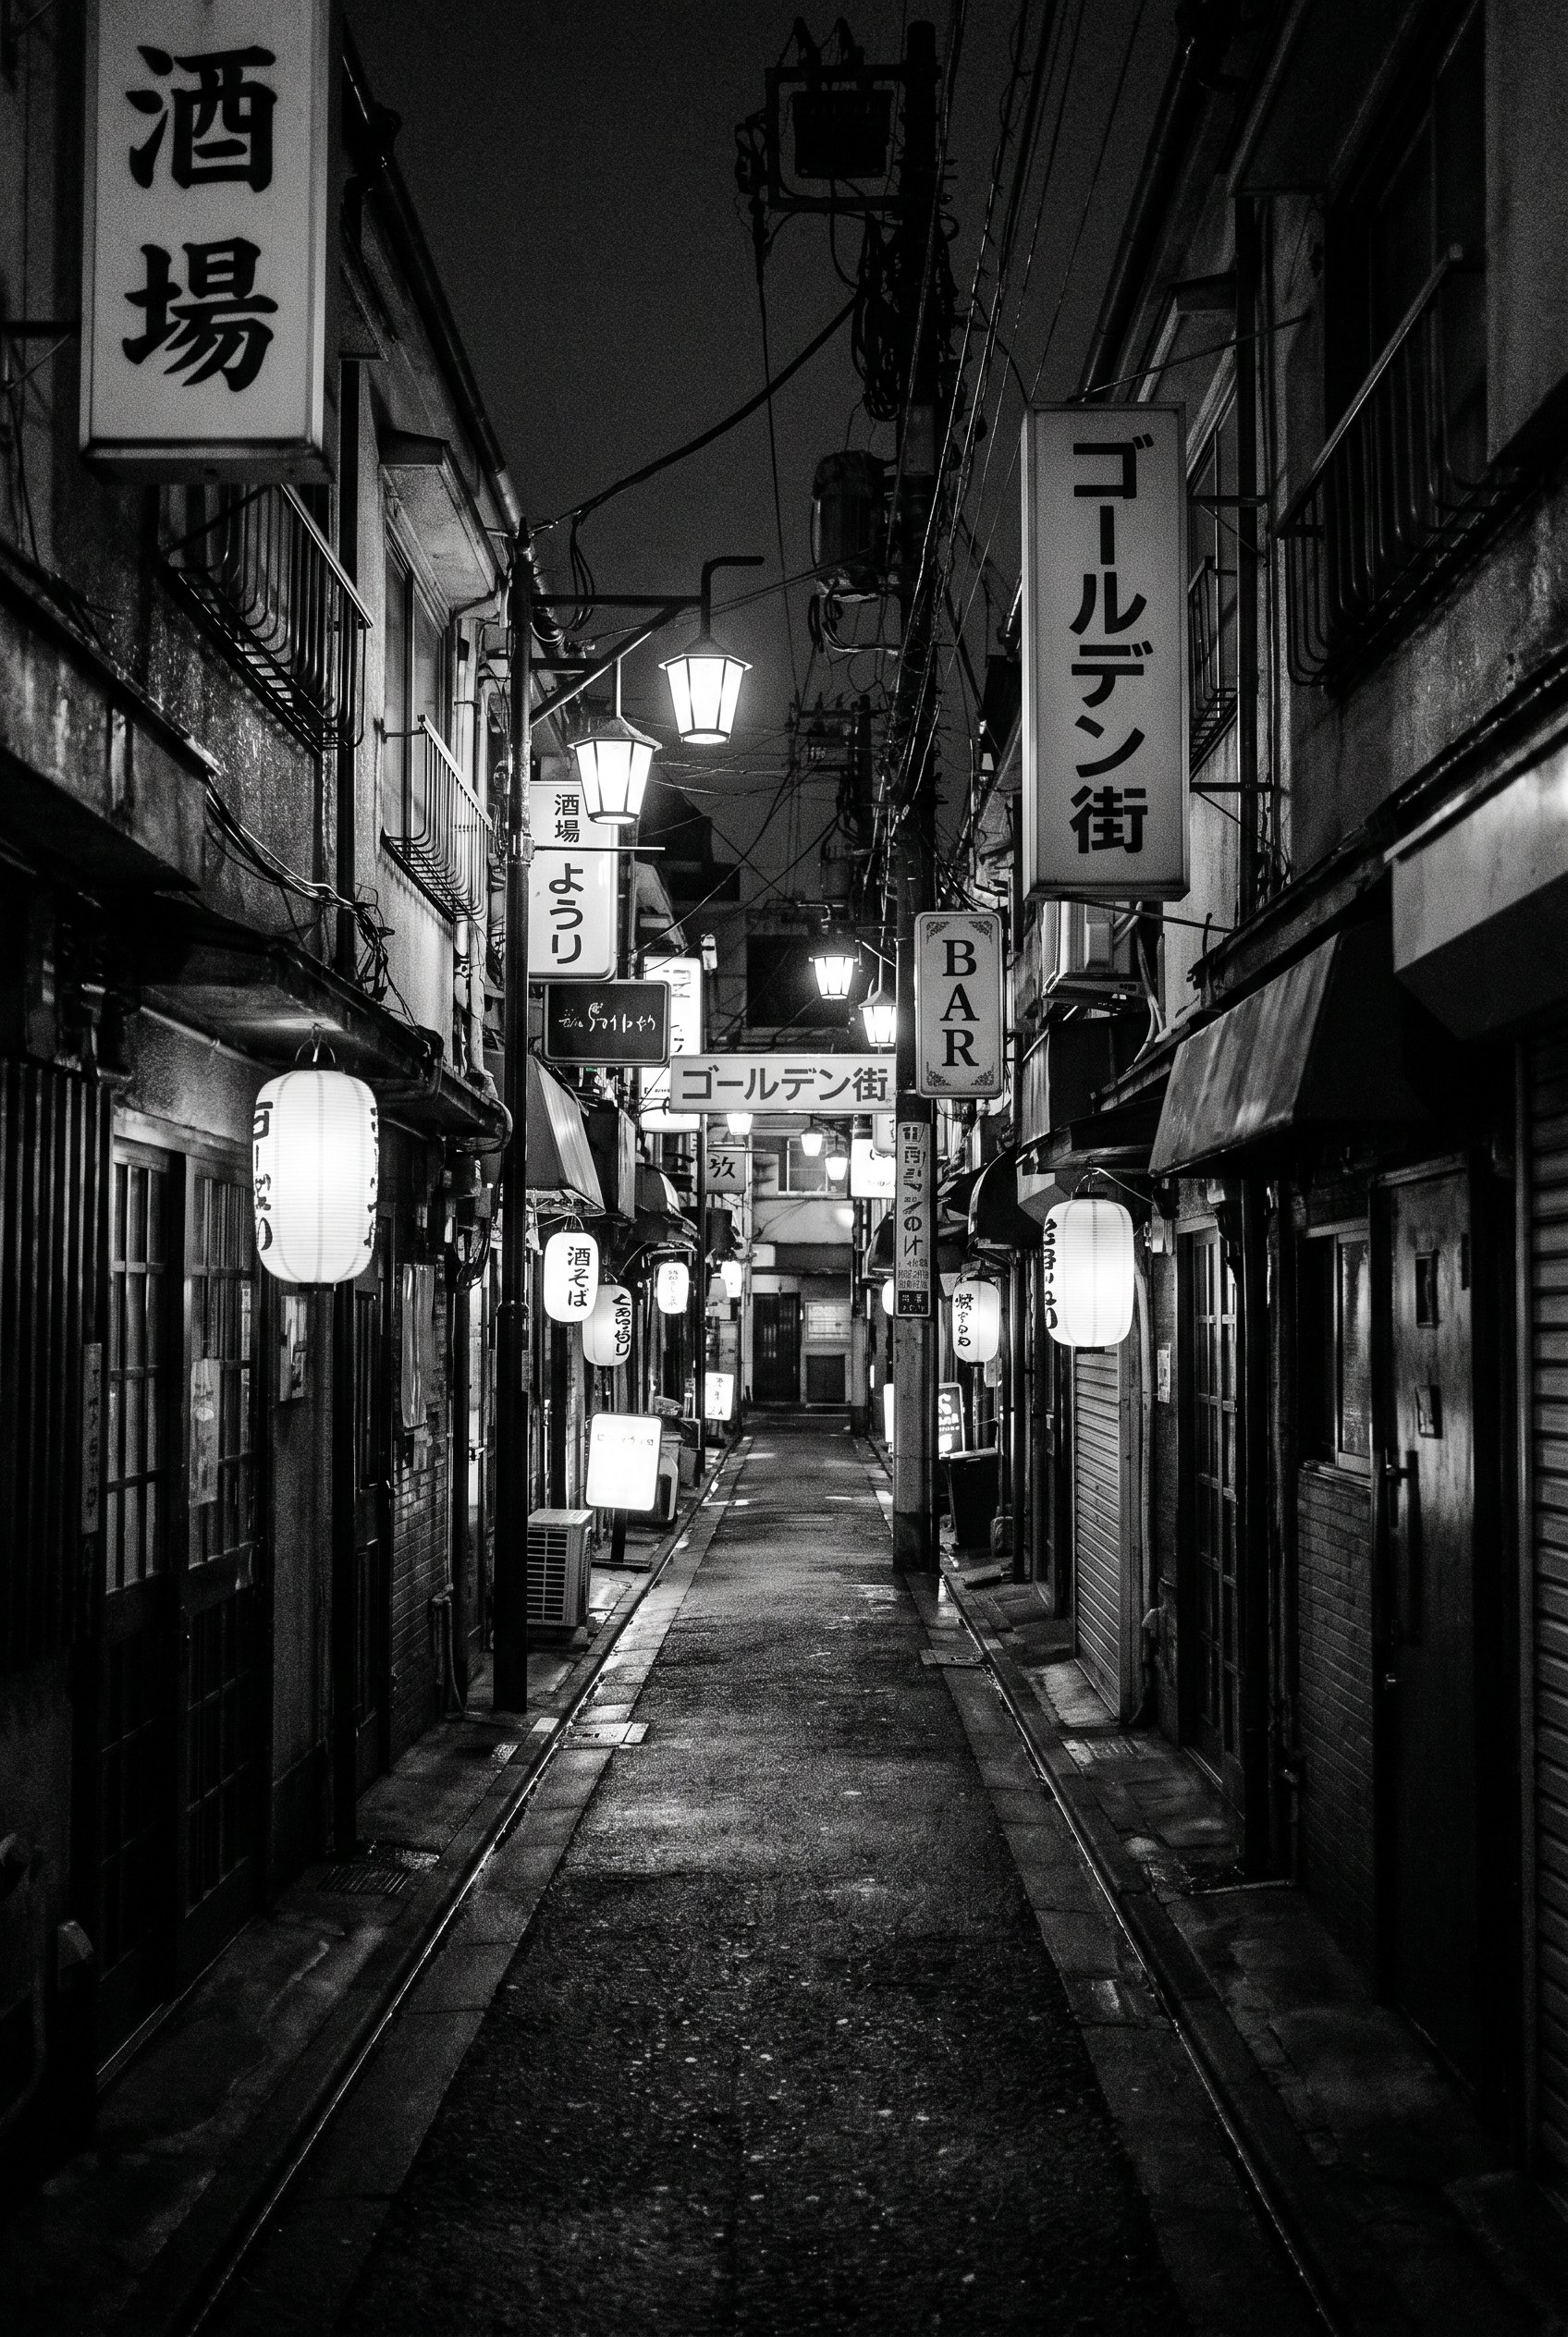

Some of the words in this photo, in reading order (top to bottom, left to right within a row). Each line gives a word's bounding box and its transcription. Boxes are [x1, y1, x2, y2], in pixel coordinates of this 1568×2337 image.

[121, 44, 278, 393] 酒場
[1069, 433, 1154, 854] ゴールデン街
[554, 793, 581, 843] 酒場
[548, 863, 583, 964] ようり
[939, 939, 980, 1067] BAR
[681, 1065, 888, 1102] ゴールデン街
[567, 1246, 591, 1307] 酒そば
